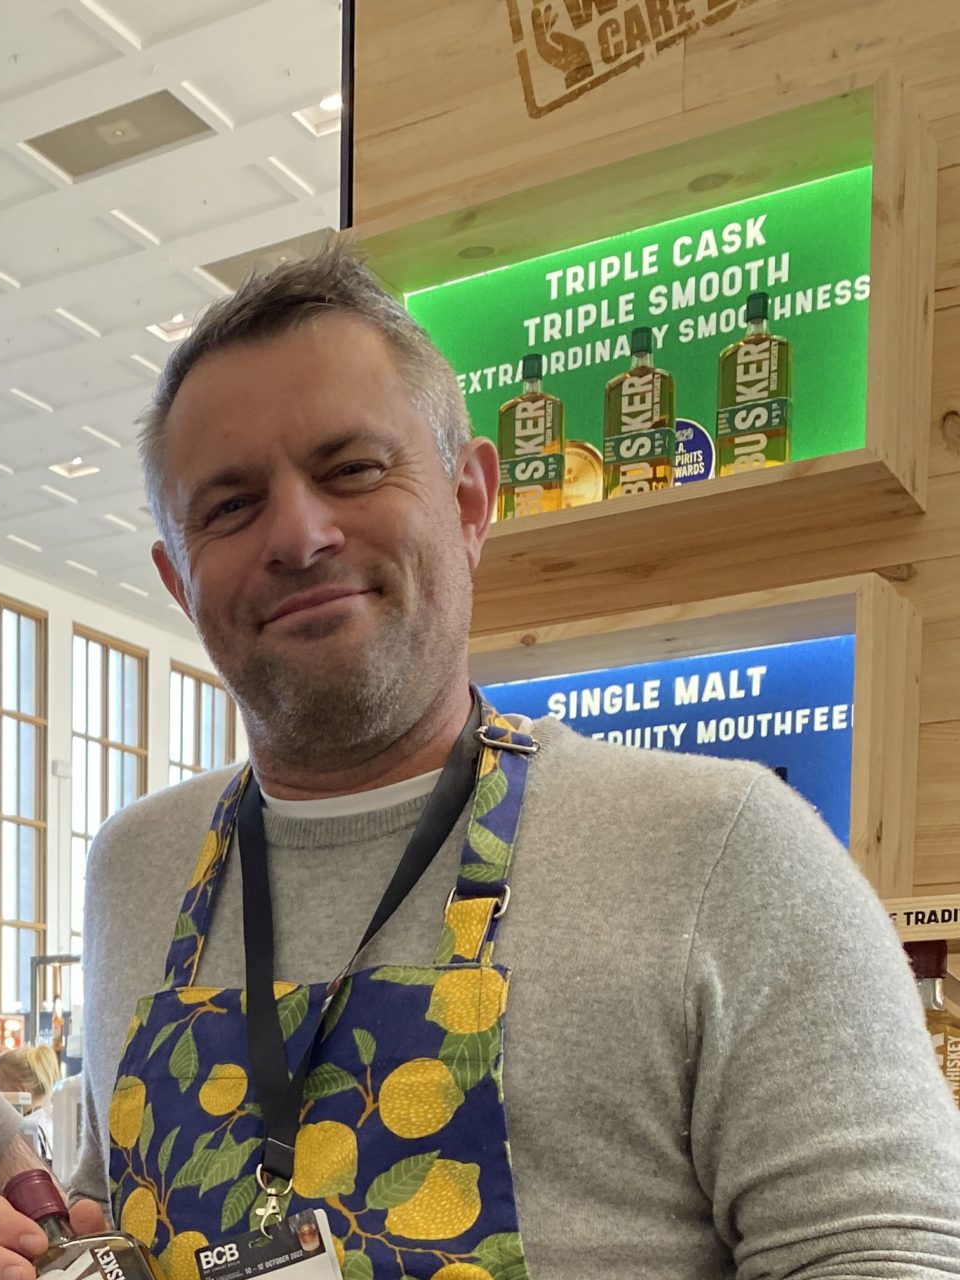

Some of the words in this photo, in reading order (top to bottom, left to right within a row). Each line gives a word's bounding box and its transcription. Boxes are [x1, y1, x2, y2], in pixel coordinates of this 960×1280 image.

[545, 243, 659, 300] TRIPLE
[673, 214, 768, 267] CASK
[523, 292, 635, 346] TRIPLE
[649, 252, 790, 315] SMOOTH
[674, 463, 705, 479] WARDS
[675, 450, 703, 466] PIRITS
[547, 679, 661, 721] SINGLE
[675, 666, 767, 706] MALT
[697, 703, 854, 745] MOUTHFEE
[903, 907, 960, 926] TRADI
[199, 1243, 240, 1270] BCB
[265, 1254, 290, 1269] OCTOBER
